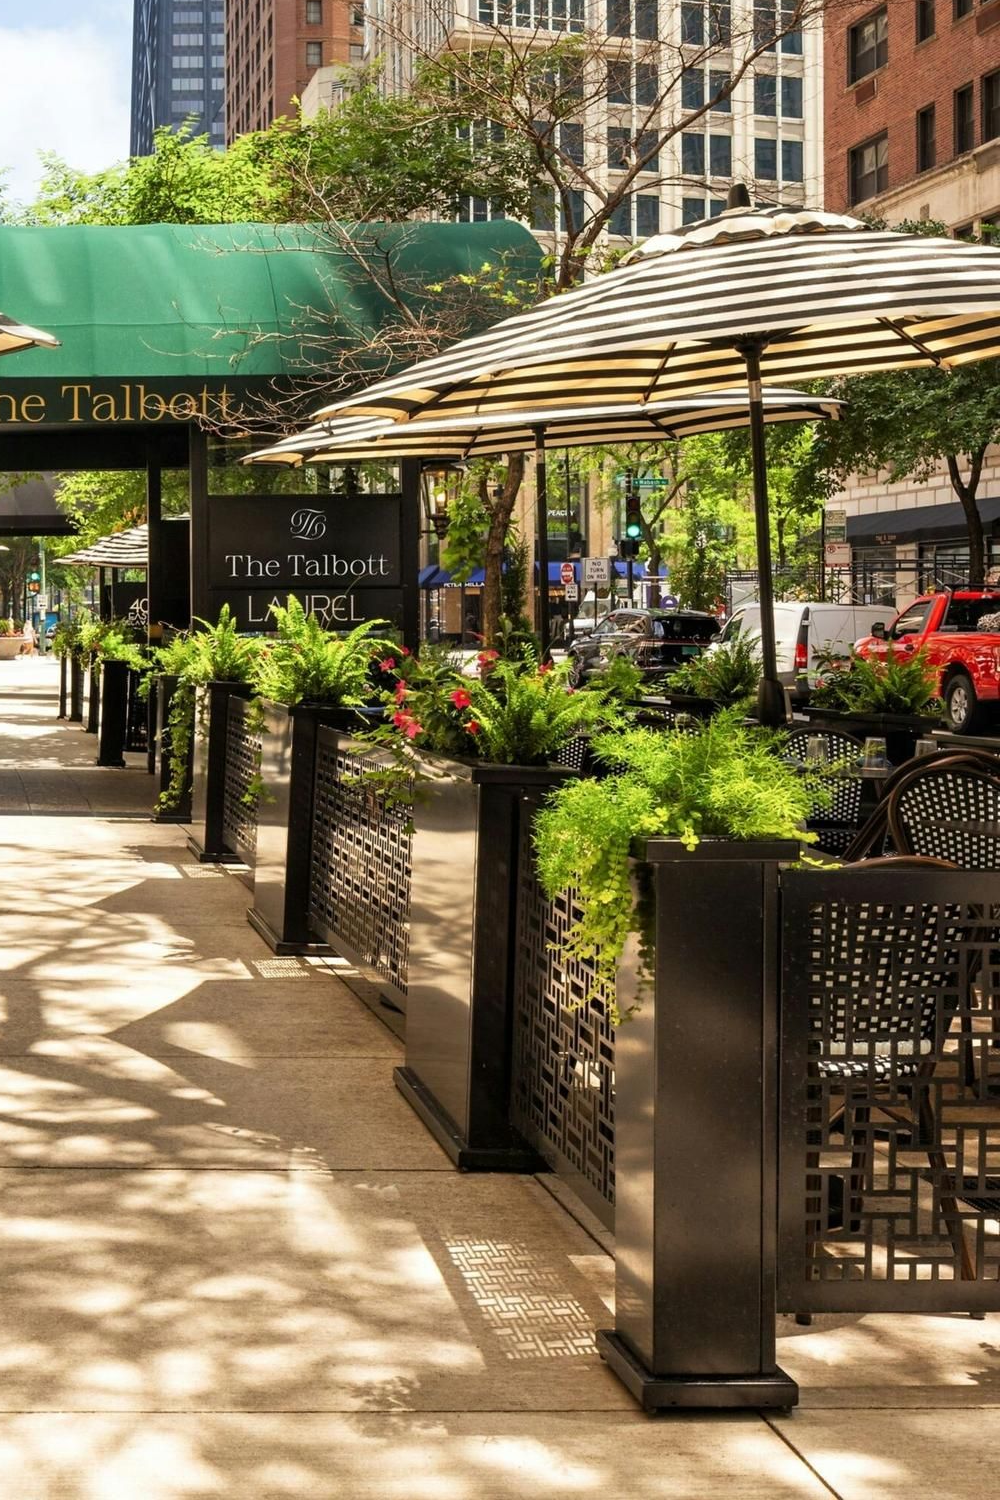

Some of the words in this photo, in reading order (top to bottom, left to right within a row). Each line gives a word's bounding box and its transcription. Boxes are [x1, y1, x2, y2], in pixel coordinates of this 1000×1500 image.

[61, 383, 237, 422] Talbott
[225, 555, 281, 577] The
[287, 553, 390, 577] Talbott
[128, 612, 148, 621] EAS
